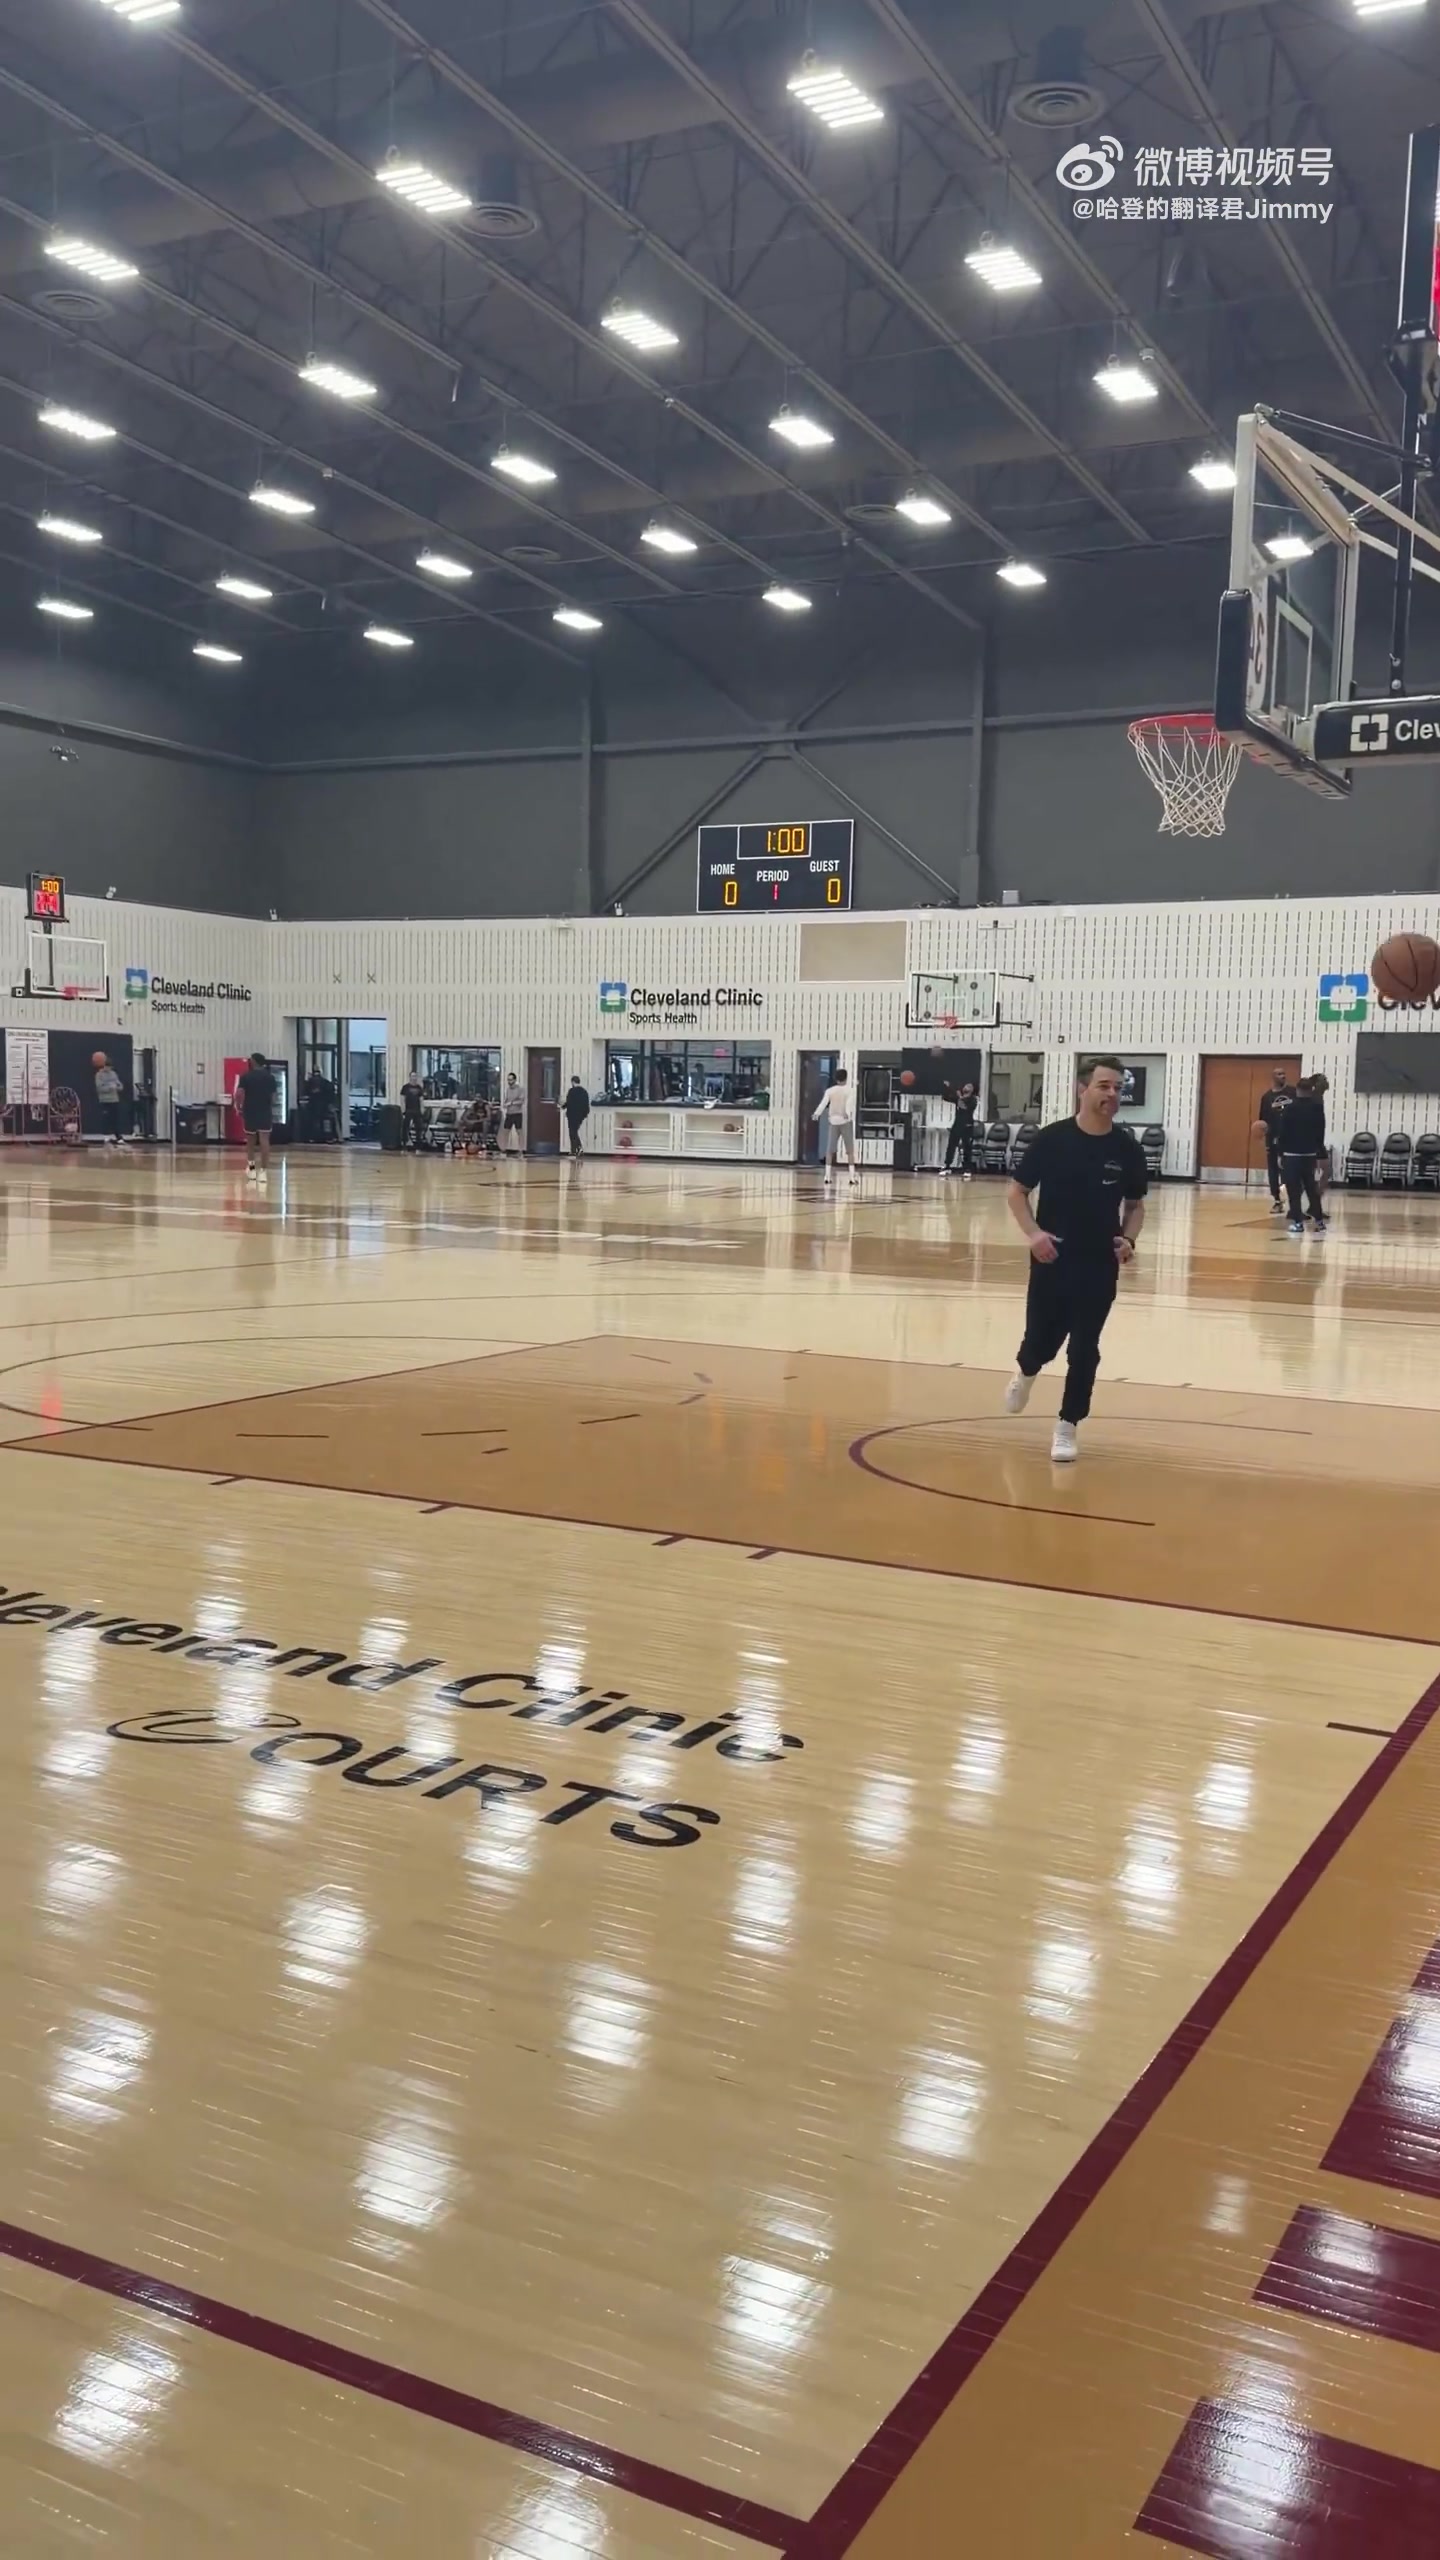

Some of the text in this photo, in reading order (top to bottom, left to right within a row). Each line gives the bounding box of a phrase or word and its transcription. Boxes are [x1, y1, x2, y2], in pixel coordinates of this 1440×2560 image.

[767, 828, 805, 853] 1:00
[710, 863, 735, 876] HOME
[756, 870, 790, 882] PERIOD
[809, 860, 840, 872] GUEST
[724, 881, 738, 905] 0
[827, 878, 841, 903] 0
[151, 976, 252, 1001] Cleveland Clinic
[630, 988, 763, 1006] Cleveland Clinic
[151, 1000, 206, 1014] Sports Health
[629, 1012, 698, 1025] Sports Health
[0, 1585, 805, 1763] leveland Clinic
[106, 1709, 722, 1848] COURTS
